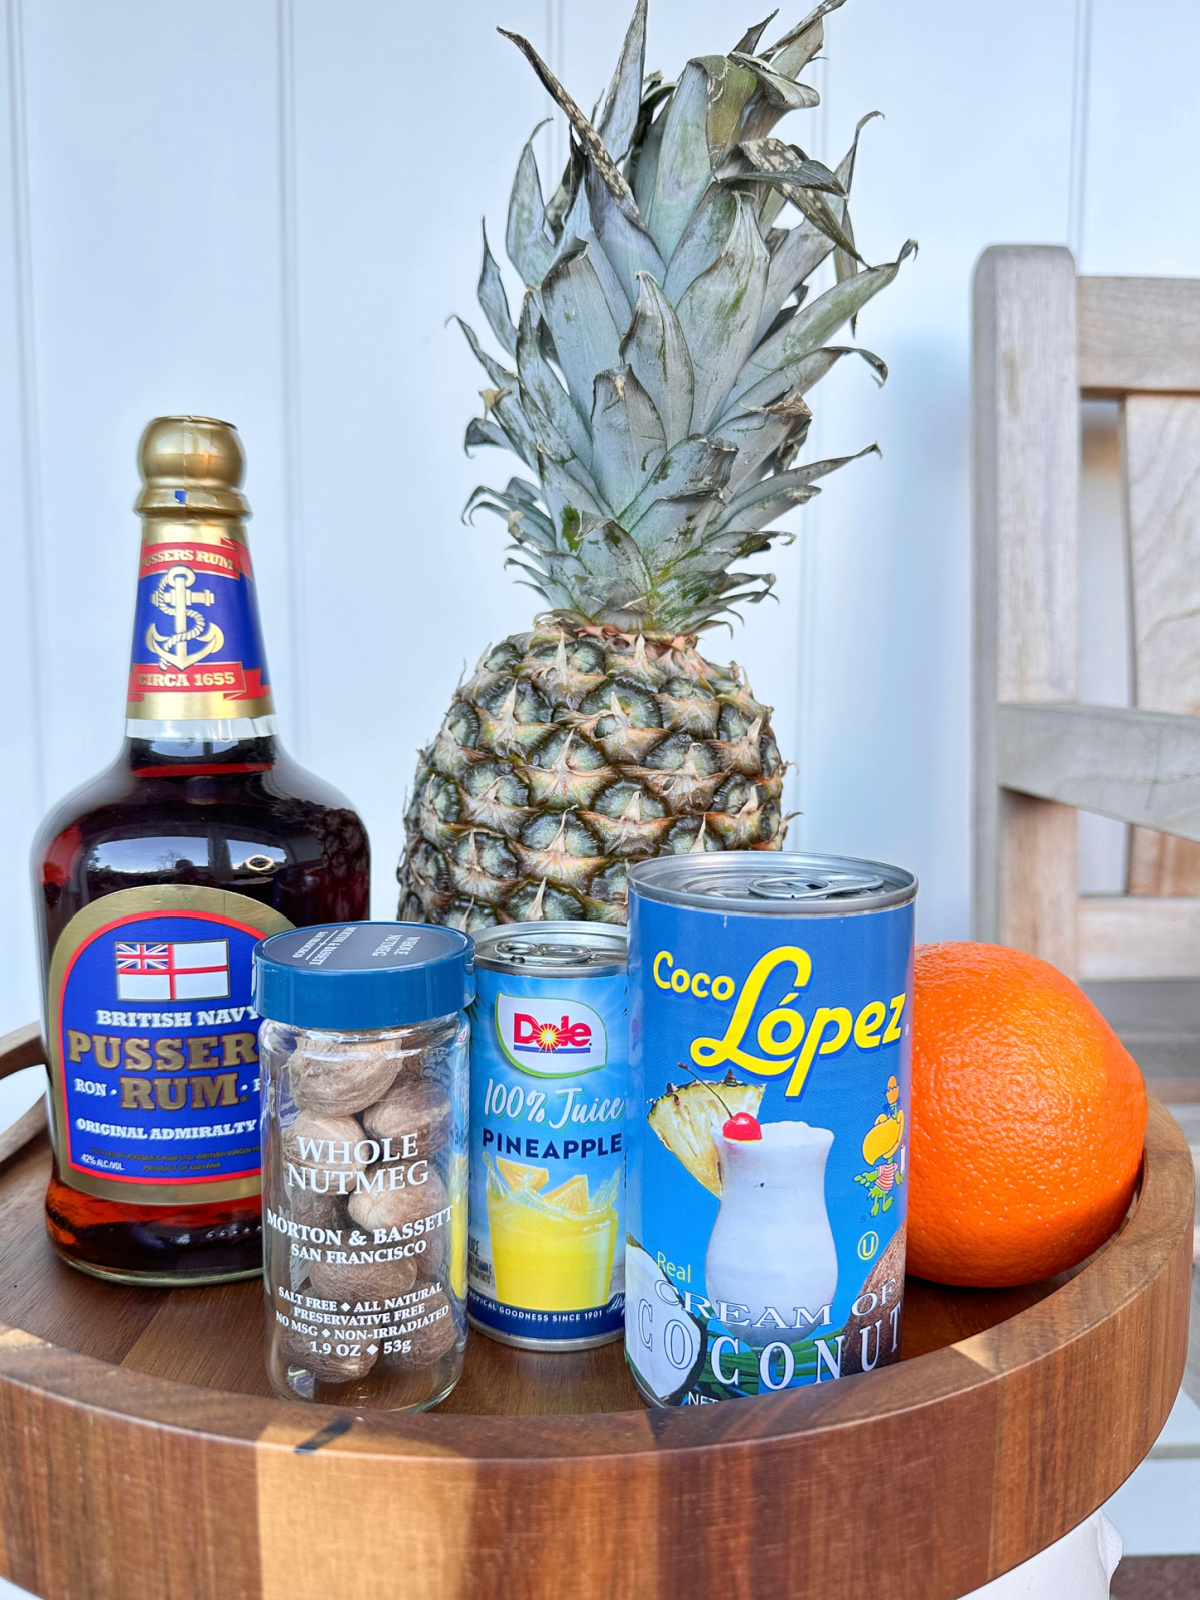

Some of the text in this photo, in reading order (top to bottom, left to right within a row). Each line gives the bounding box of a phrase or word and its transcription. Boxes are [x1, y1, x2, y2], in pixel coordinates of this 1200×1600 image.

[196, 550, 234, 570] RUM
[138, 672, 236, 687] CIRCA 1655
[96, 1005, 259, 1028] BRITISH NAVY
[513, 1013, 593, 1050] Dole
[653, 946, 906, 1097] Coco López
[74, 1078, 107, 1096] RON
[484, 1078, 625, 1130] 100% Juice
[75, 1118, 257, 1141] ORIGINAL ADMIRALTY
[482, 1127, 622, 1160] PINEAPPLE
[297, 1132, 418, 1166] WHOLE
[287, 1160, 429, 1195] NUTMEG
[266, 1205, 453, 1247] MORTON & BASSETT
[290, 1239, 427, 1265] SAN FRANCISCO
[657, 1251, 692, 1283] Real
[278, 1282, 443, 1314] SALT FREE ALL NATURAL
[293, 1302, 426, 1326] PRESERVATIVE FREE
[654, 1279, 834, 1330] CREAM
[851, 1277, 897, 1317] OF
[276, 1305, 449, 1340] NO MSG NON-IRRADIATED
[499, 1306, 549, 1322] GOODNESS
[552, 1314, 581, 1323] SINCE
[584, 1310, 603, 1321] 1901
[309, 1338, 412, 1358] 1.9 OZ 53g
[637, 1298, 902, 1390] COCONUT
